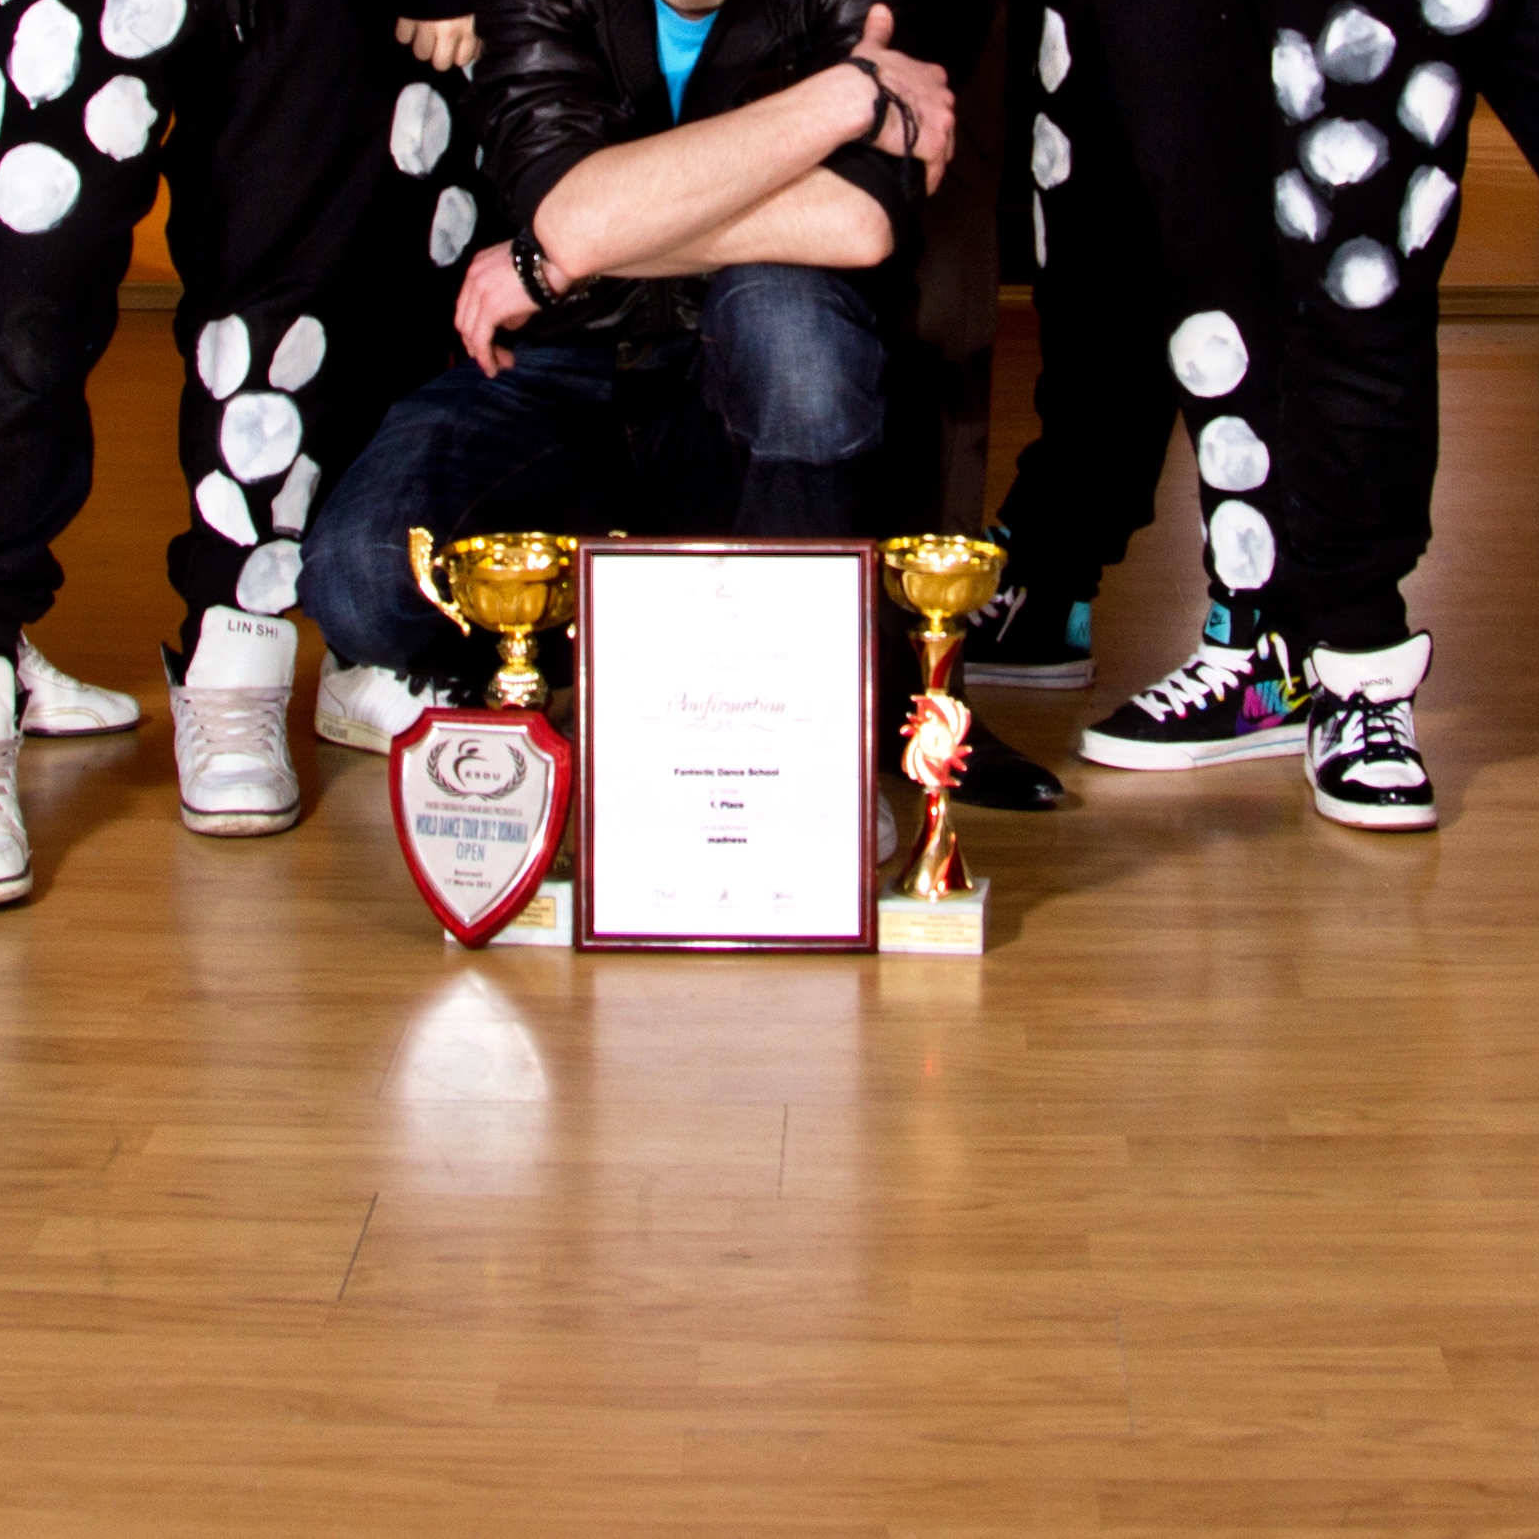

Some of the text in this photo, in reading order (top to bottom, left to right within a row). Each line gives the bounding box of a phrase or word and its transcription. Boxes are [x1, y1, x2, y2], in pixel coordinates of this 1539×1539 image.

[227, 619, 279, 639] LIN SHI
[1243, 675, 1302, 719] NIKE
[673, 768, 780, 777] Fantastic Dance School
[719, 800, 745, 810] Place
[416, 814, 437, 836] WORLD
[438, 816, 460, 839] DANCE
[455, 842, 486, 861] OPEN
